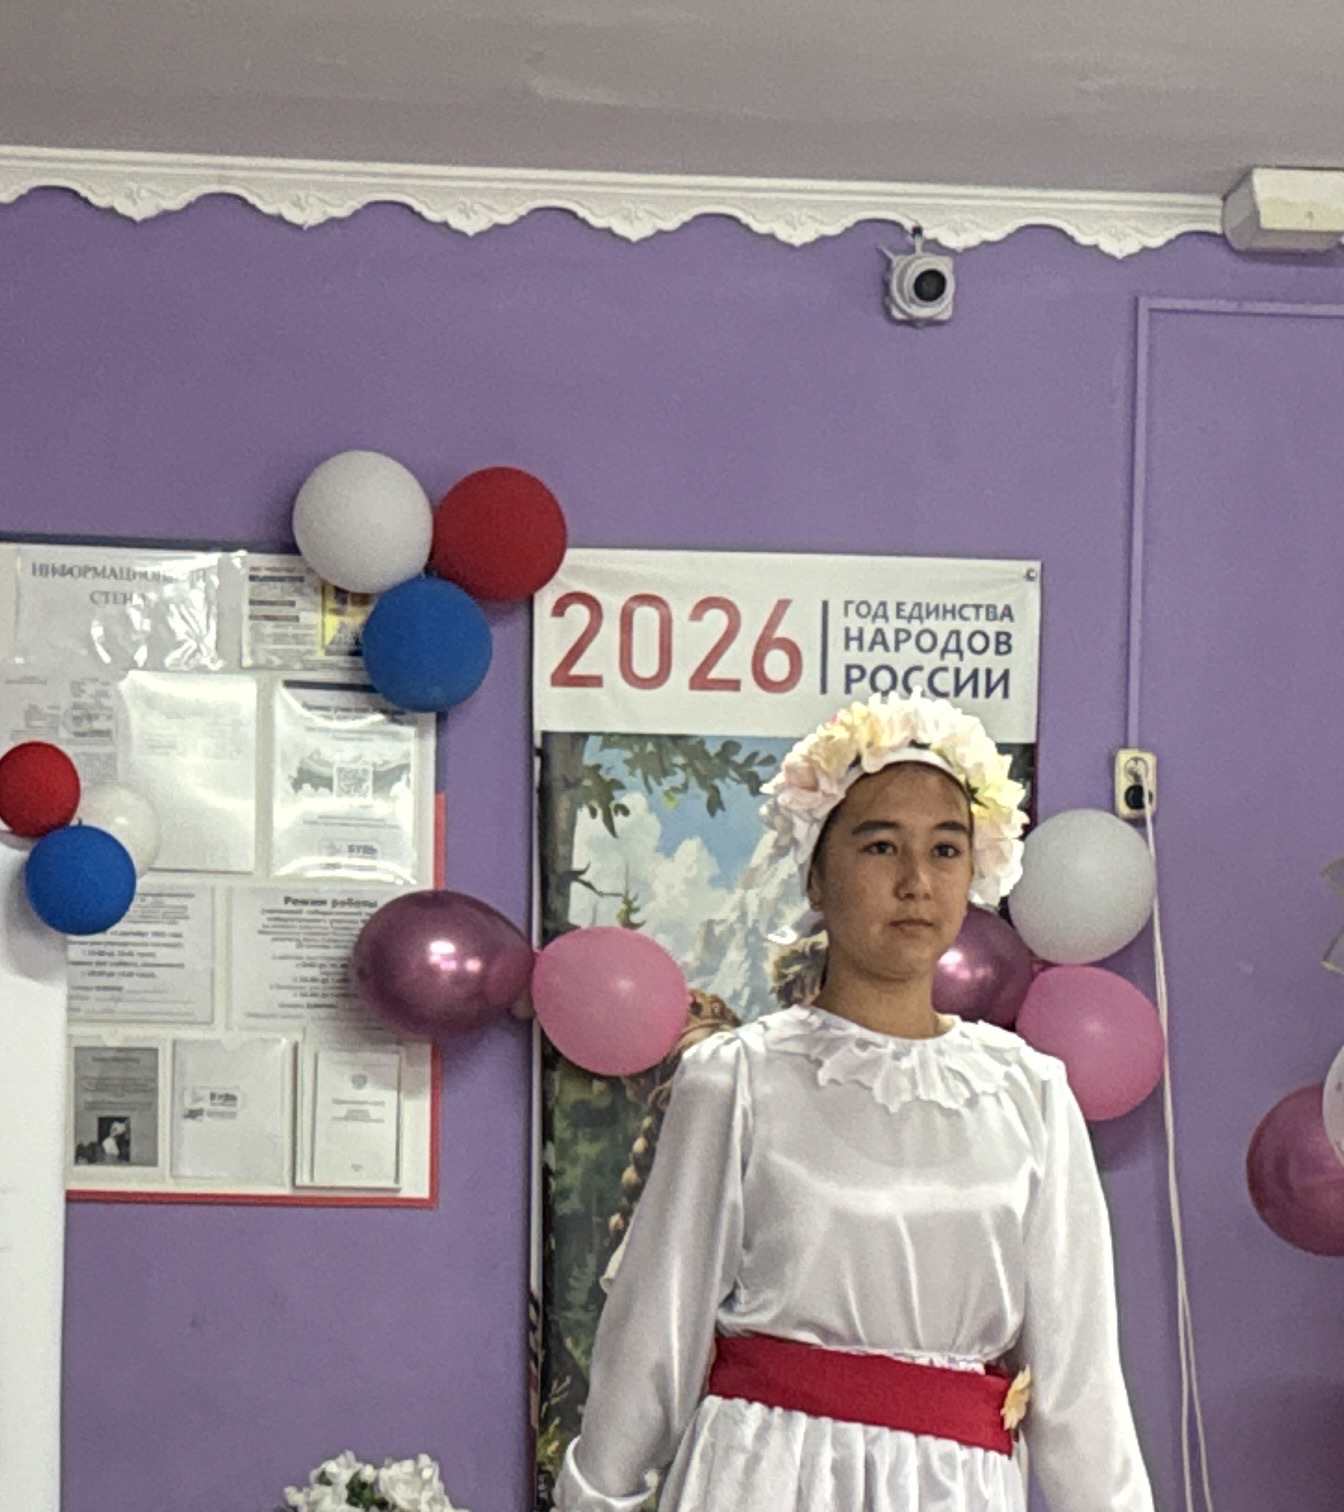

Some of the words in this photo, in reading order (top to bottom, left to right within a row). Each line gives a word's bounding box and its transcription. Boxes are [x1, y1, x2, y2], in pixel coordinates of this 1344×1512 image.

[89, 591, 147, 606] СТЕН
[843, 600, 890, 624] ГОД
[895, 601, 1015, 624] ЕДИНСТВА
[550, 590, 804, 694] 2026
[843, 626, 1014, 661] НАРОДОВ
[843, 664, 1011, 699] РОССИИ
